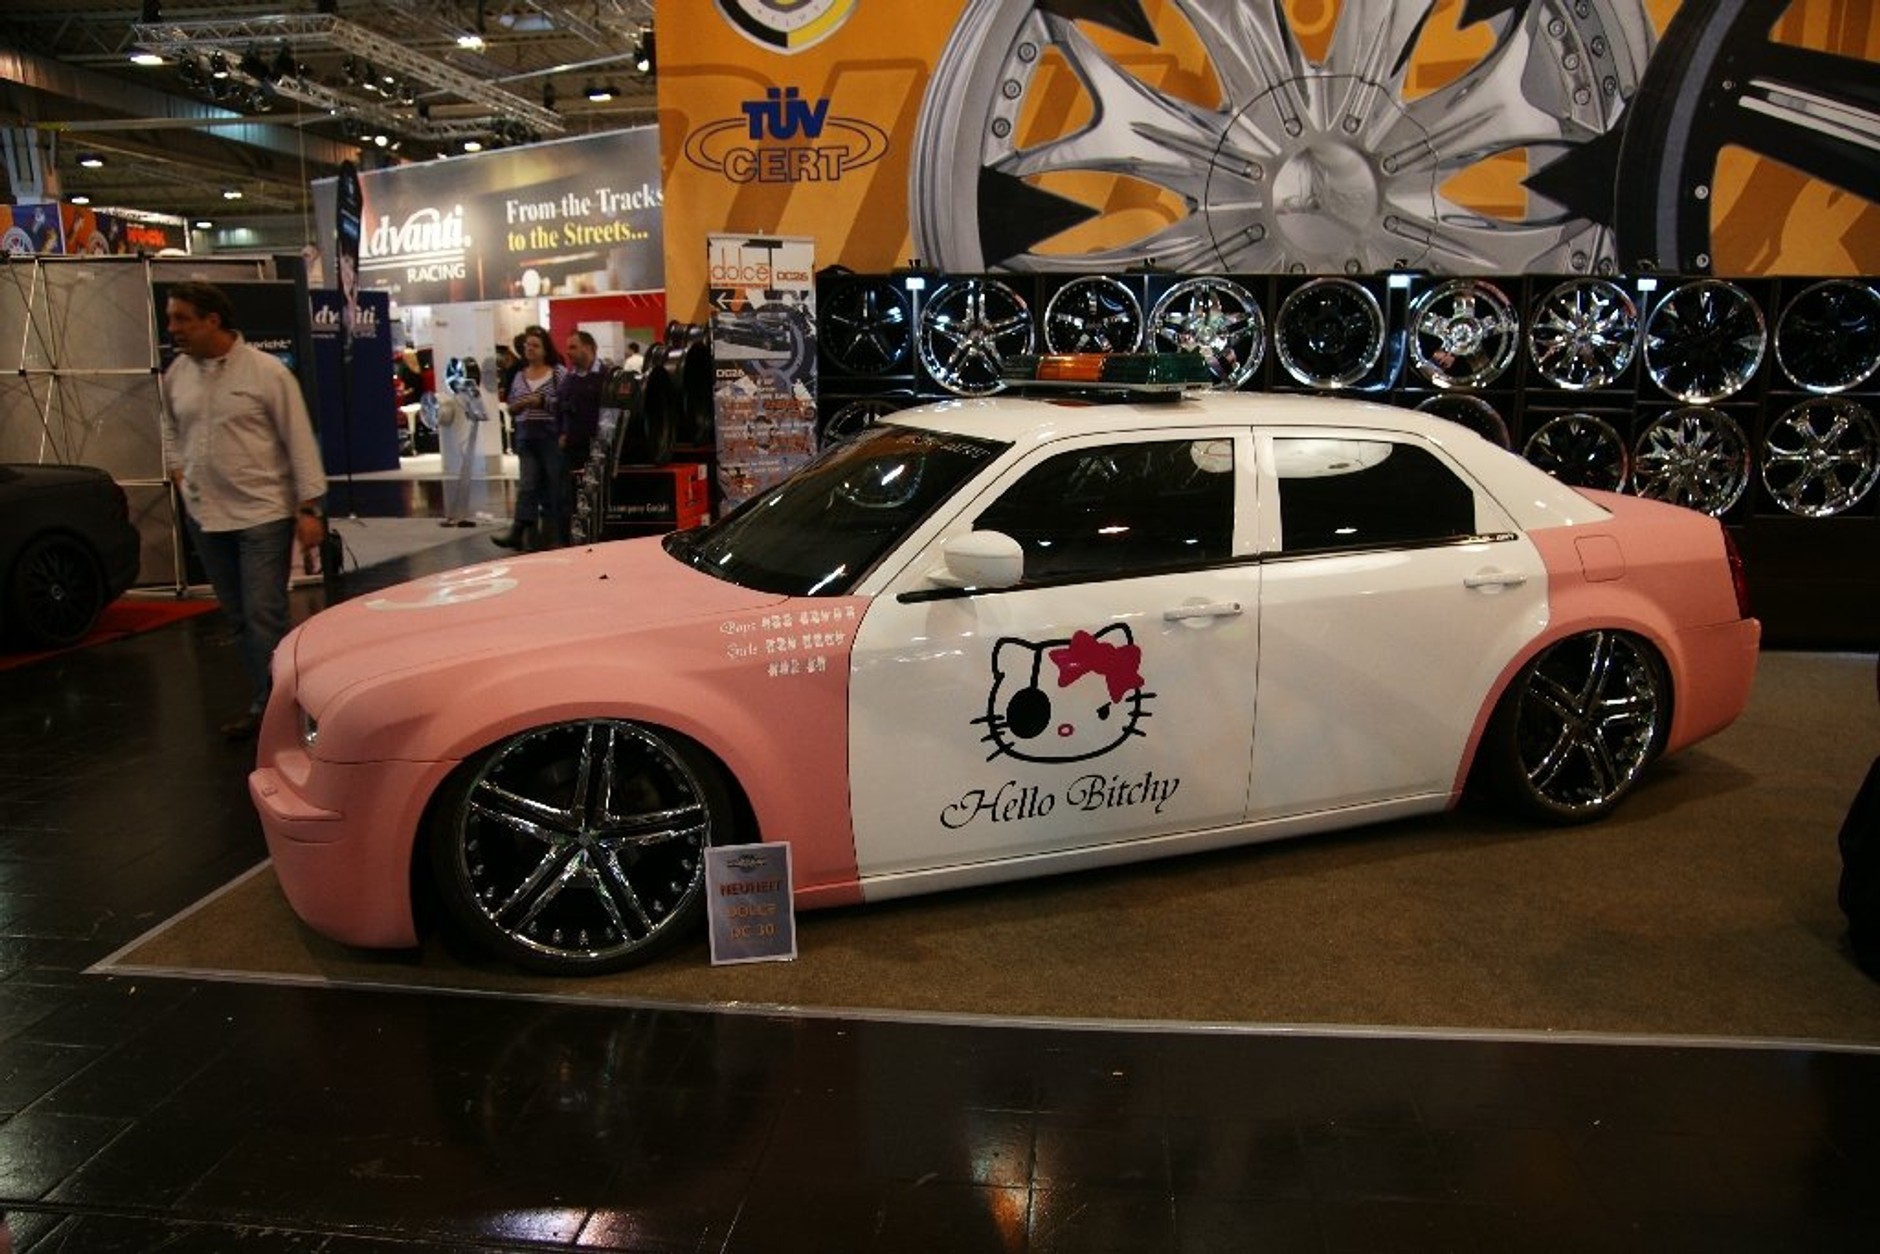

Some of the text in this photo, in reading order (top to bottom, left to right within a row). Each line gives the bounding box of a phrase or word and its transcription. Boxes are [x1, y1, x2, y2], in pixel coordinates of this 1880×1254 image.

[741, 87, 829, 140] TÜV
[724, 146, 850, 184] CERT
[506, 200, 556, 224] From
[562, 193, 591, 218] the
[507, 220, 648, 252] to the Streets...
[407, 263, 466, 283] RACING
[940, 771, 1180, 829] Hello Bitchy
